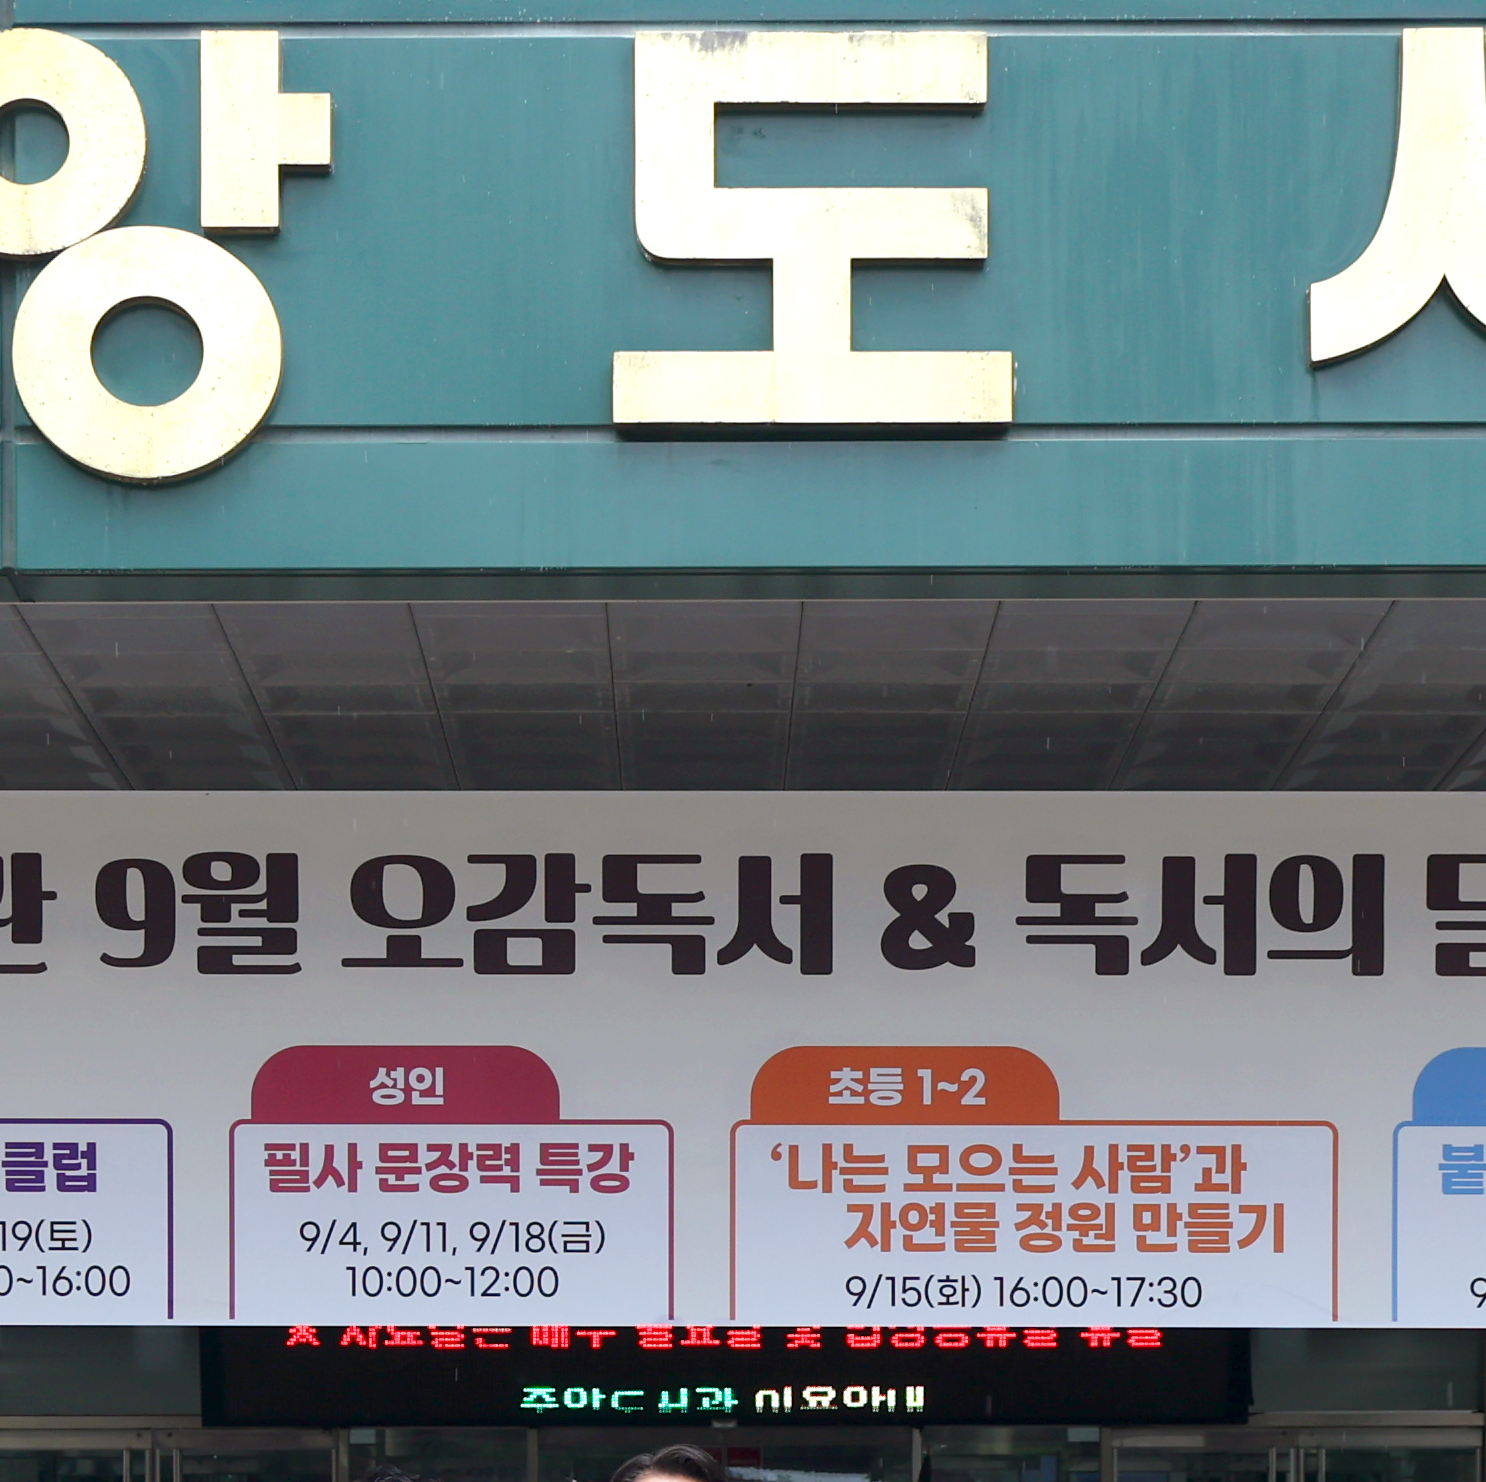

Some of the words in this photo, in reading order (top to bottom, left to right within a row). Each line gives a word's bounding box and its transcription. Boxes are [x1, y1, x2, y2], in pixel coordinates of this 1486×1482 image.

[95, 852, 301, 974] 9월
[341, 853, 833, 975] 오감독서
[881, 864, 975, 970] &
[1016, 854, 1385, 976] 독서의
[370, 1067, 444, 1105] 성인
[829, 1067, 904, 1106] 초등
[917, 1068, 986, 1105] 1~2
[2, 1142, 96, 1192] 클럽
[264, 1143, 363, 1192] 필사
[375, 1143, 520, 1193] 문장력
[536, 1143, 634, 1193] 특강
[903, 1144, 1058, 1193] 모으는
[300, 1219, 367, 1256] 9/4,
[381, 1220, 456, 1255] 9/11,
[470, 1220, 605, 1254] 9/18(금)
[845, 1202, 999, 1252] 자연물
[1014, 1202, 1115, 1253] 정원
[1133, 1203, 1284, 1253] 만들기
[346, 1266, 558, 1297] 10:00~12:00
[846, 1274, 981, 1309] 9/15(화)
[994, 1276, 1202, 1307] 16:00~17:30
